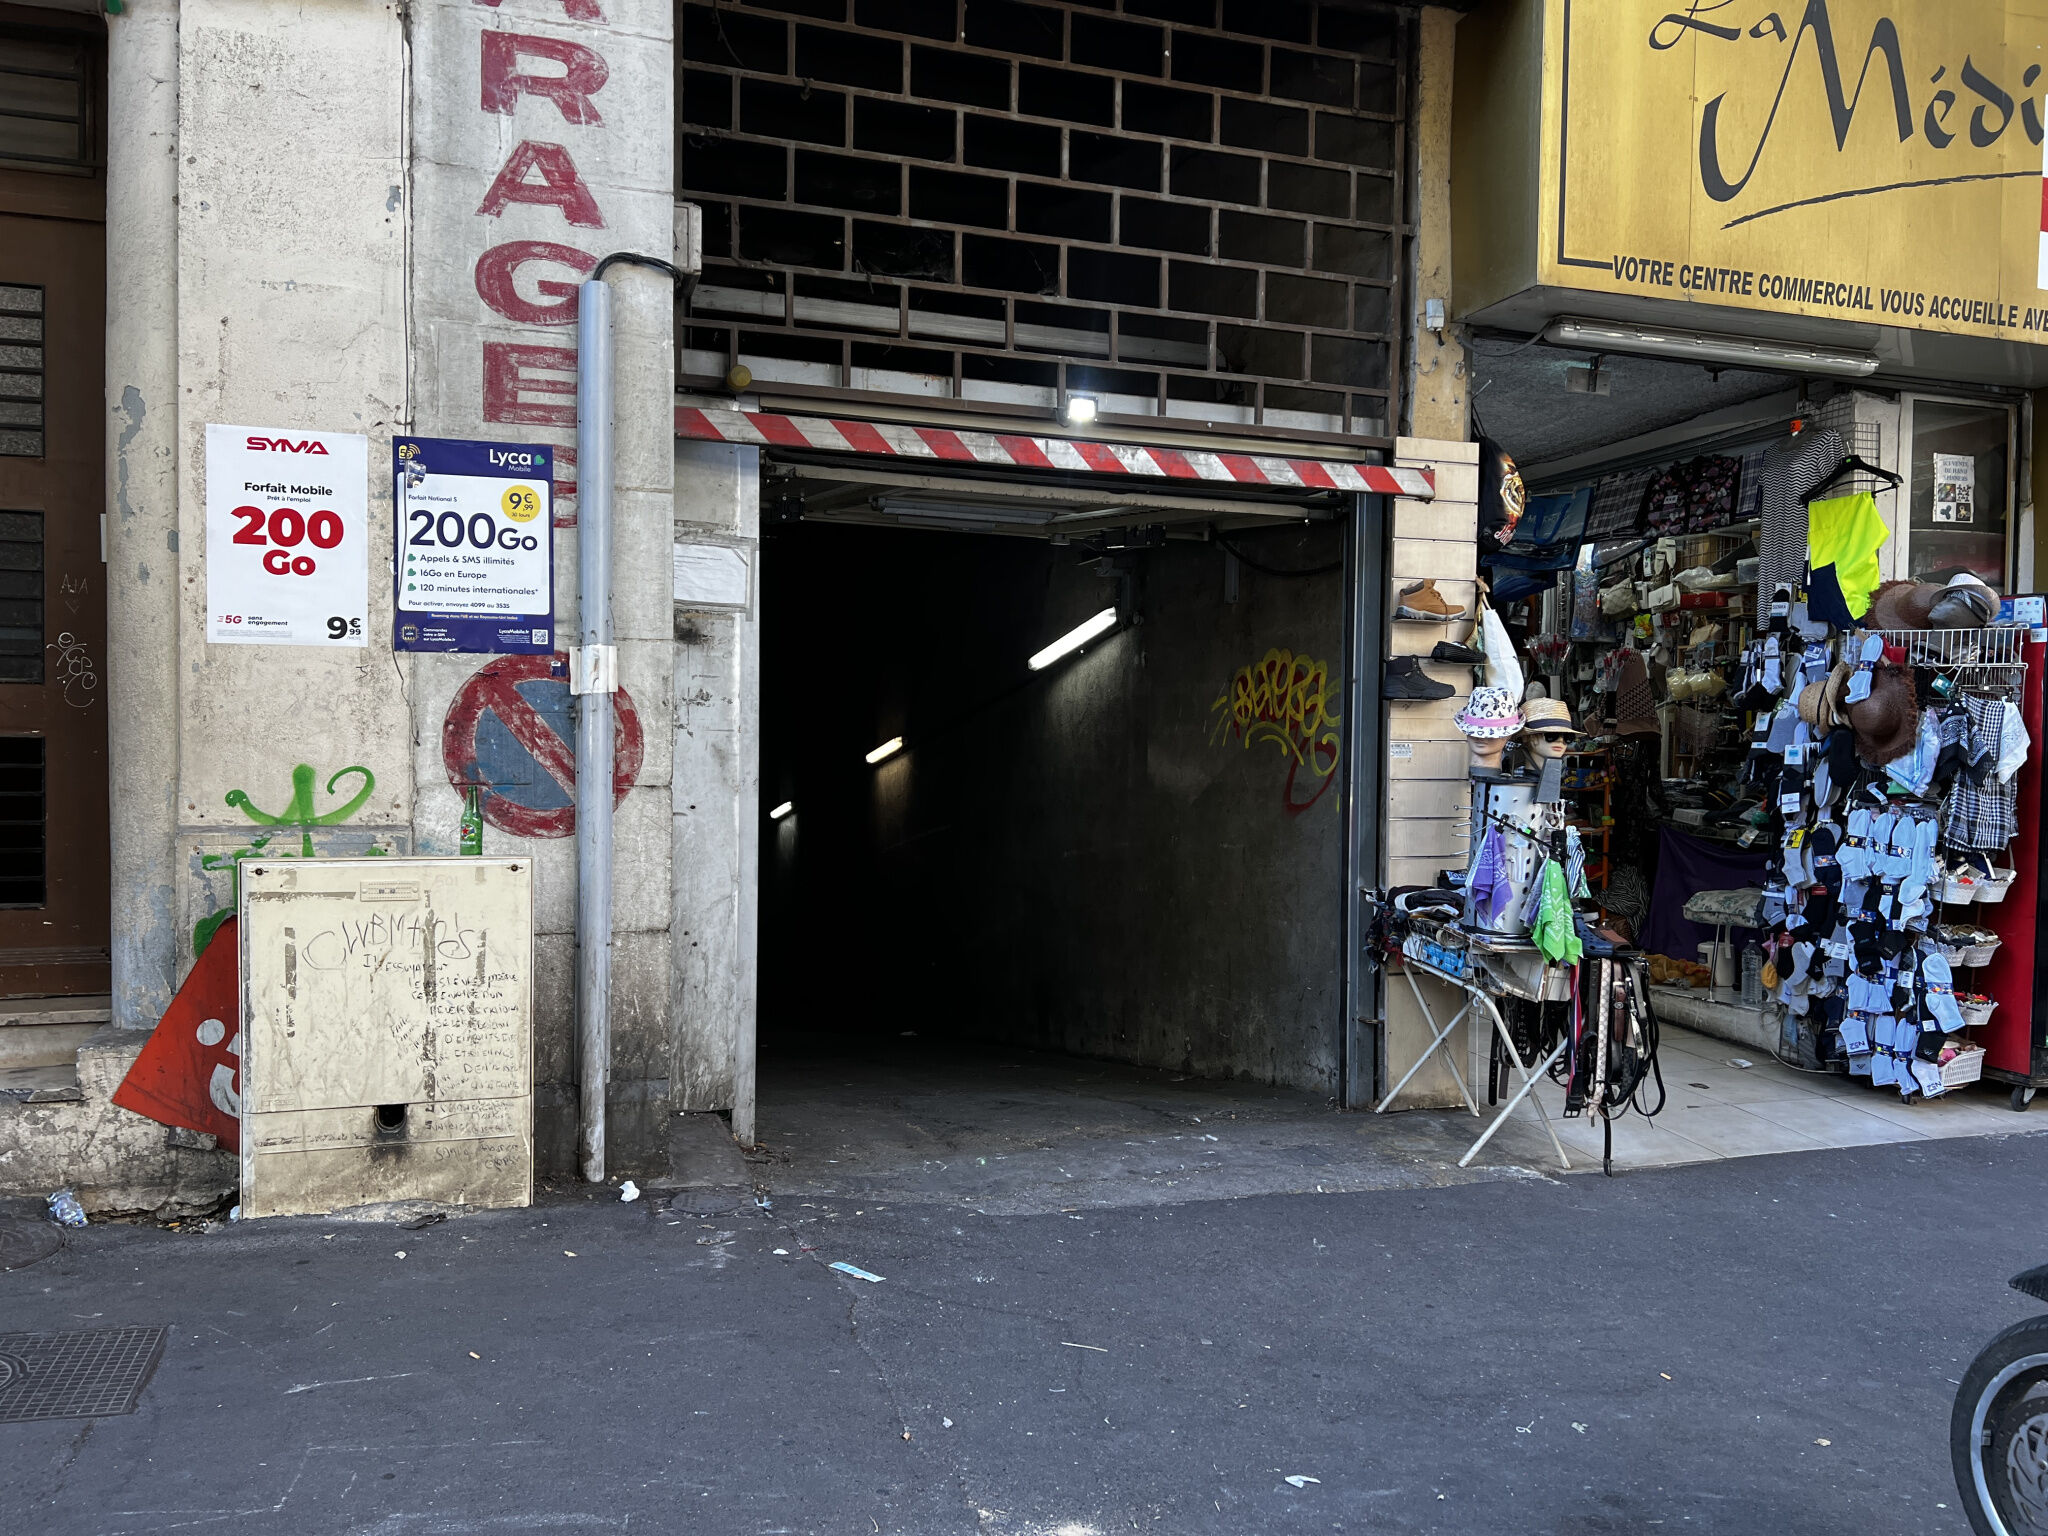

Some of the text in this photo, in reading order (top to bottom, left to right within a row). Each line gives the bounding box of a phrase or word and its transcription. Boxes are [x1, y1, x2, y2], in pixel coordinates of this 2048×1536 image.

[475, 0, 609, 427] RAGE
[1613, 254, 1674, 286] VOTRE
[1679, 263, 1753, 296] CENTRE
[1758, 273, 1874, 311] COMMERCIAL
[1880, 288, 1925, 317] VOUS
[1928, 295, 2018, 328] ACCUEILLE
[246, 436, 330, 456] SYMA
[489, 448, 531, 467] Lyca
[244, 482, 332, 496] Forfait Mobile
[230, 505, 344, 549] 200
[262, 549, 316, 576] Go
[420, 554, 515, 566] Appels & SMS illimités
[420, 569, 442, 578] 16Go
[457, 570, 487, 580] Europe
[420, 584, 434, 592] 120
[436, 584, 470, 594] minutes
[225, 614, 242, 624] 5G
[326, 616, 361, 640] 9 €
